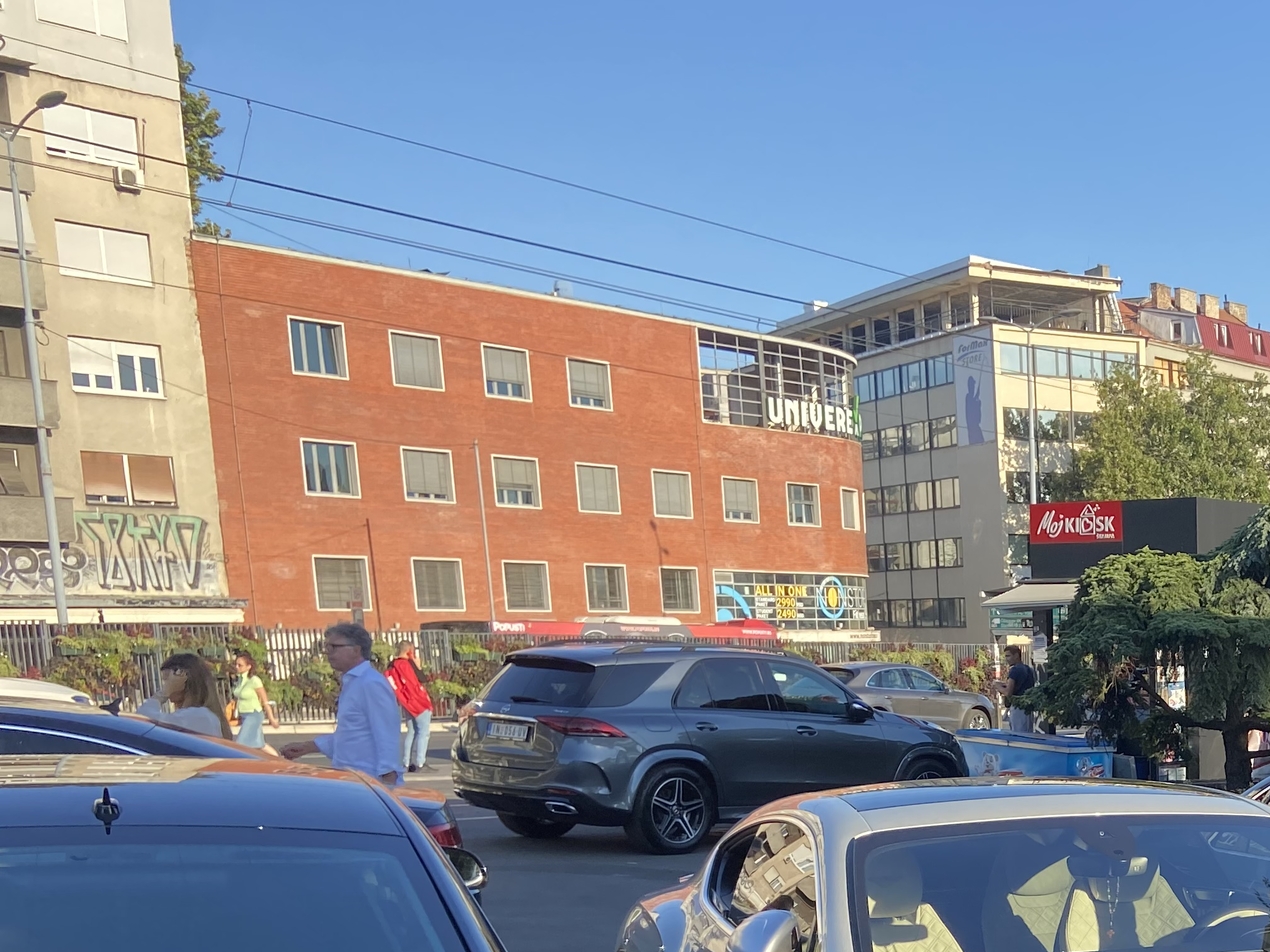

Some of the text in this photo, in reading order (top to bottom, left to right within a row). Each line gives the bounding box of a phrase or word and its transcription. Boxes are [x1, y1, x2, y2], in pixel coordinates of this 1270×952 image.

[962, 353, 982, 366] STORE
[1065, 510, 1115, 535] KIOSK
[755, 585, 808, 597] ALL IN ONE
[776, 597, 796, 607] 2990
[777, 609, 797, 619] 2490
